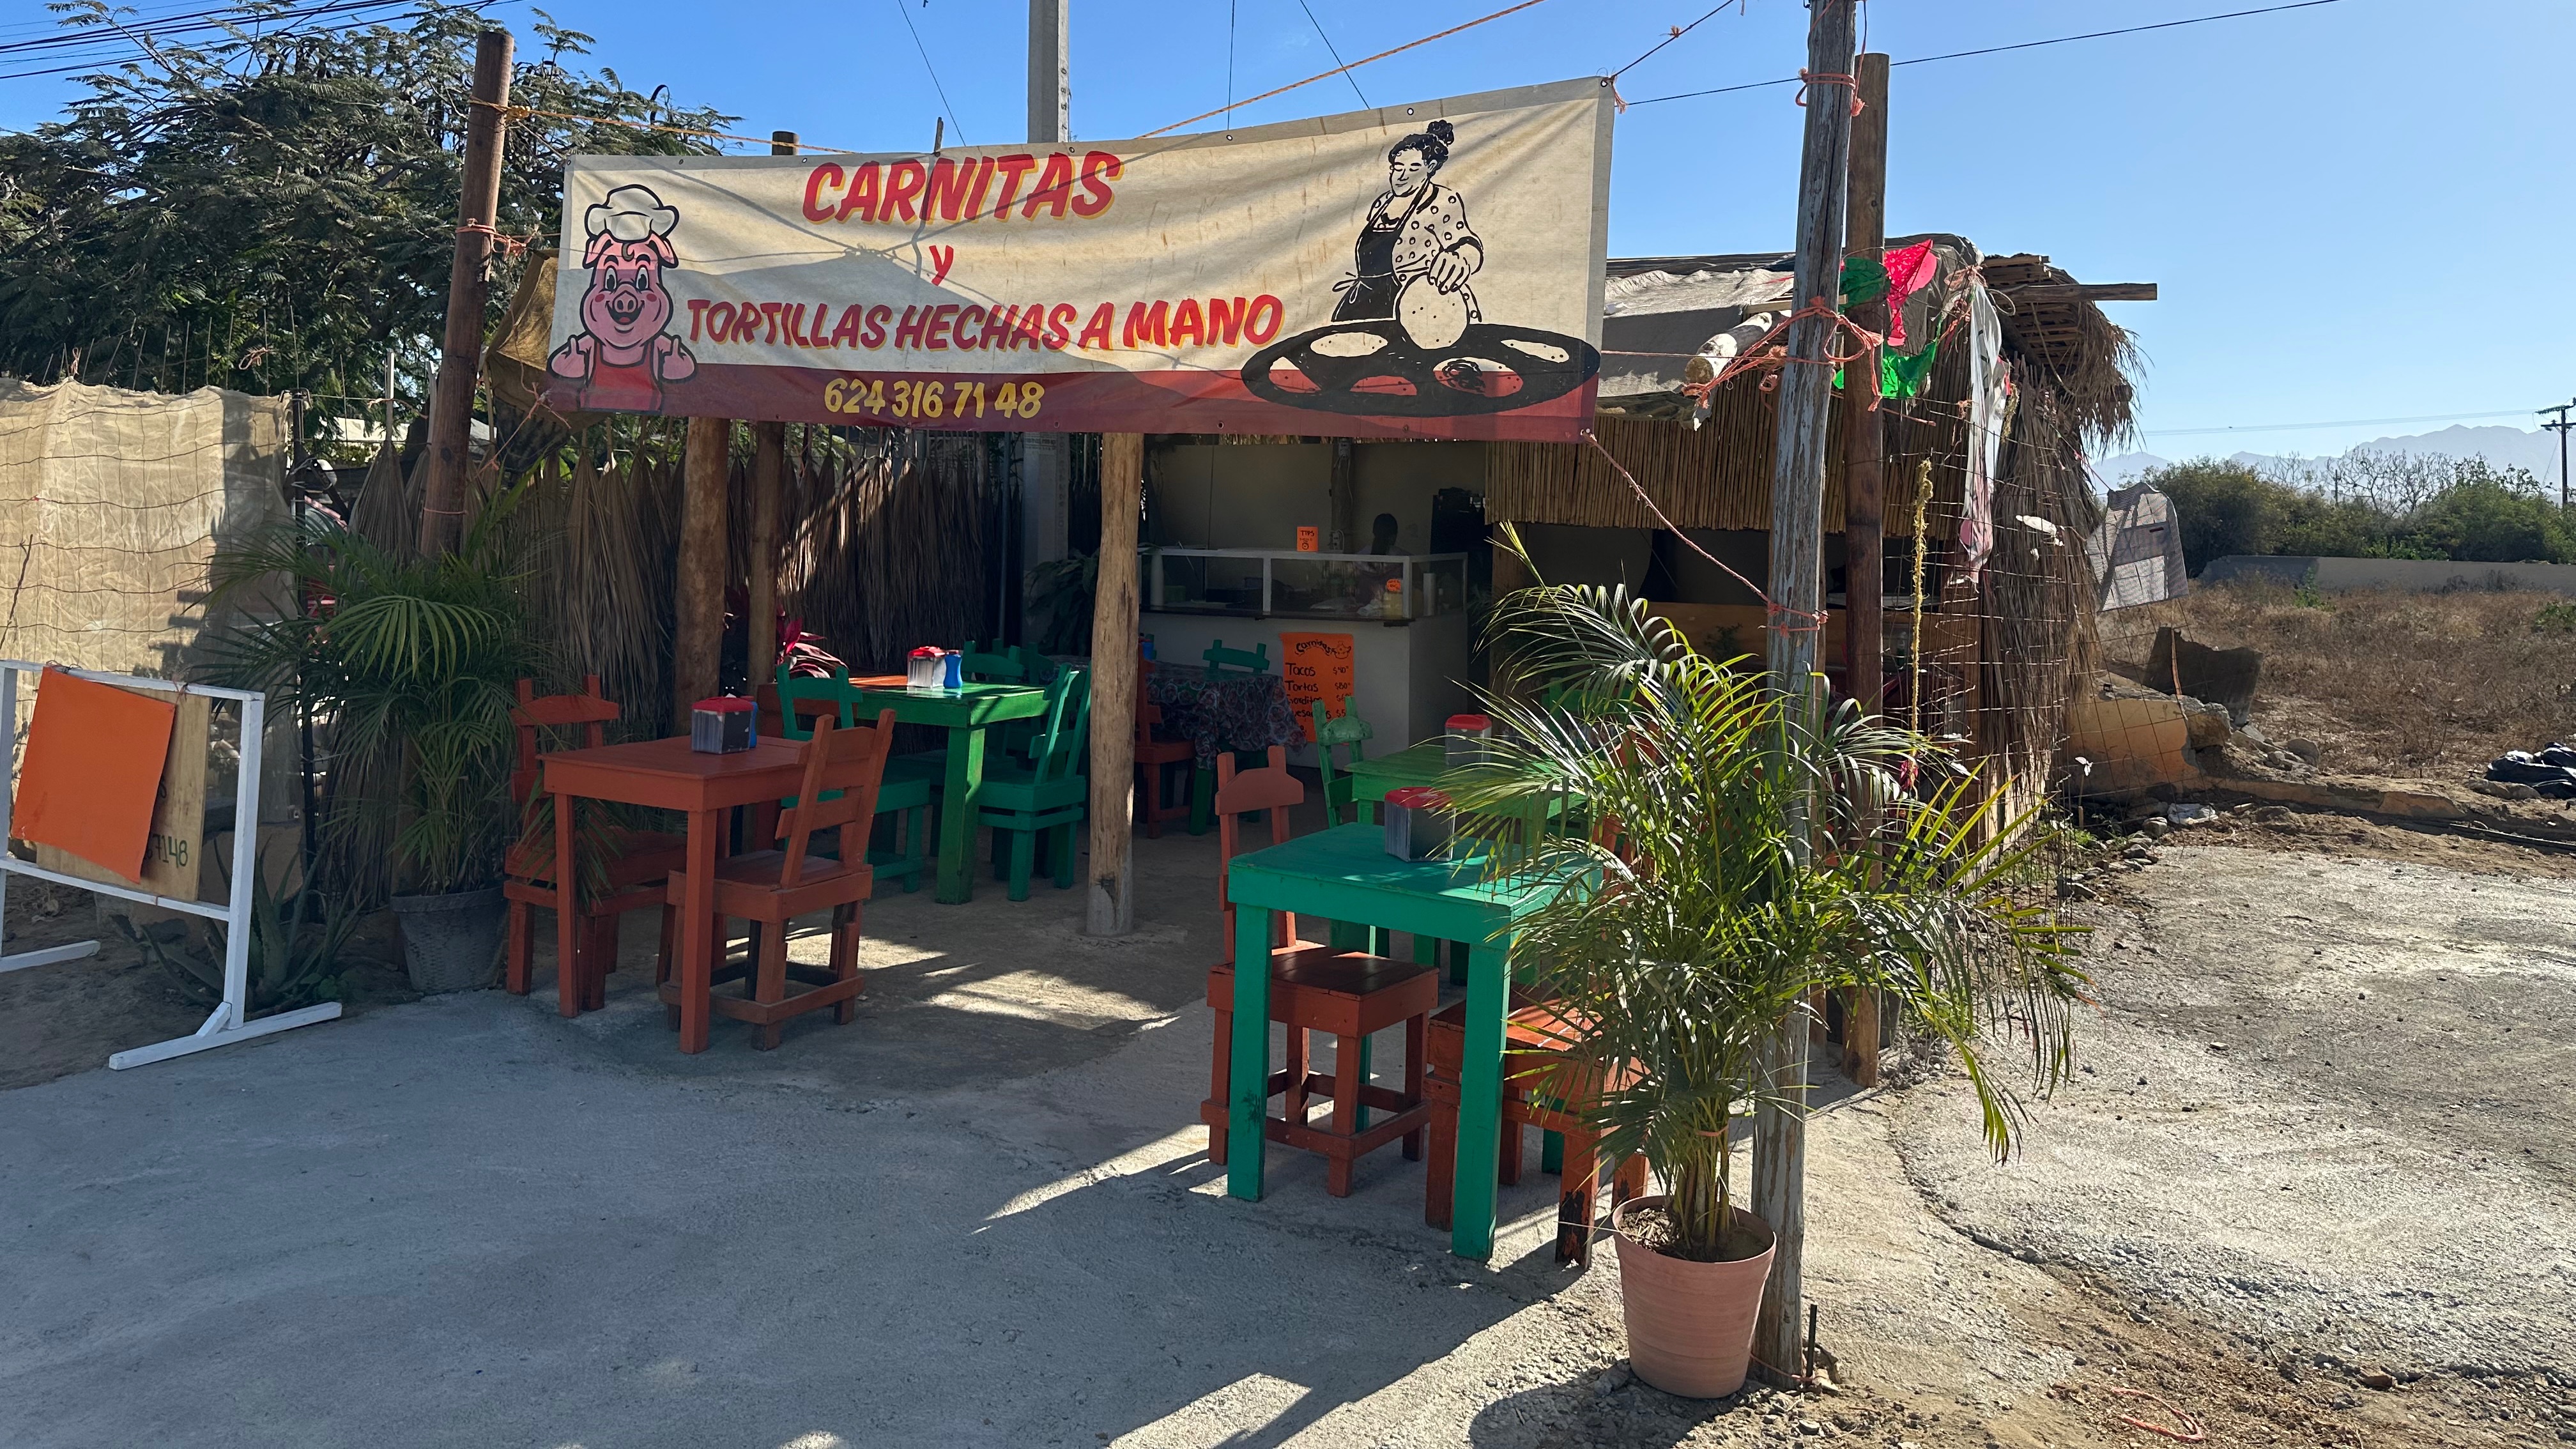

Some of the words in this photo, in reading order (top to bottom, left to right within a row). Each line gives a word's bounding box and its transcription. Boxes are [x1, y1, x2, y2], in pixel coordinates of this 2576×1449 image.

[802, 151, 1124, 225] CARNITAS
[687, 299, 893, 351] TORTILLAS
[894, 303, 1078, 352] HECHAS
[1077, 301, 1116, 351] A
[1123, 295, 1285, 349] MANO
[824, 378, 885, 415] 624
[892, 380, 944, 418] 316
[953, 381, 985, 418] 71
[995, 381, 1045, 418] 48
[1284, 680, 1318, 692] Tortas
[1285, 663, 1315, 677] Tacos
